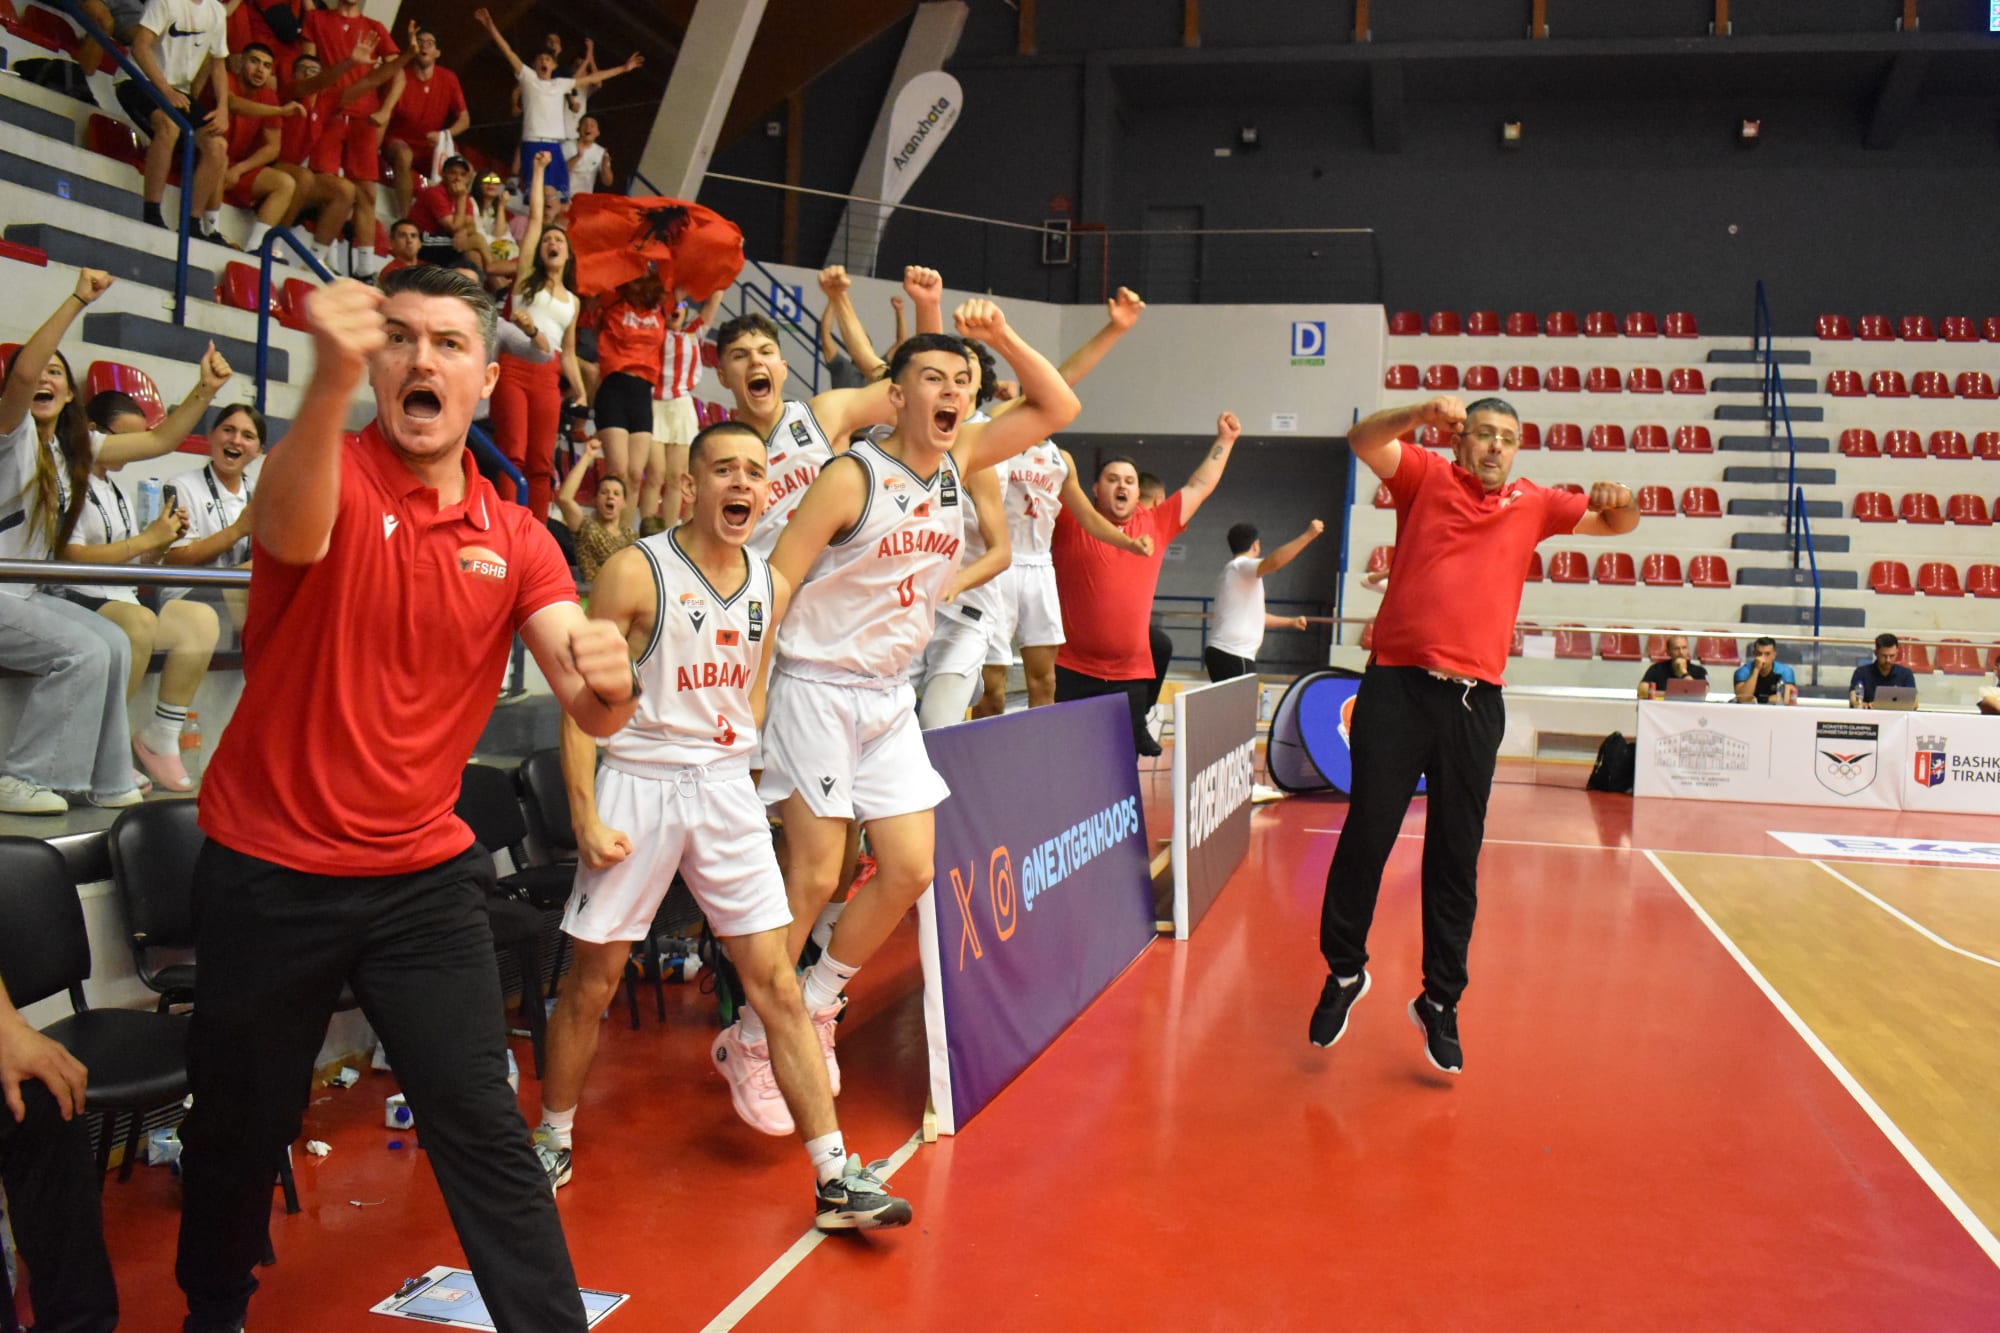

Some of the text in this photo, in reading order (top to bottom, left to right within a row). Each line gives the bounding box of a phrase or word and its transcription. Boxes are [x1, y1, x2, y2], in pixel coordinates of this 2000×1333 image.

[1295, 321, 1322, 355] D
[1010, 469, 1055, 494] ALBANIA
[878, 529, 960, 560] ALBANIA
[473, 561, 506, 578] FSHB
[1022, 794, 1138, 912] @NEXTGENHOOPS
